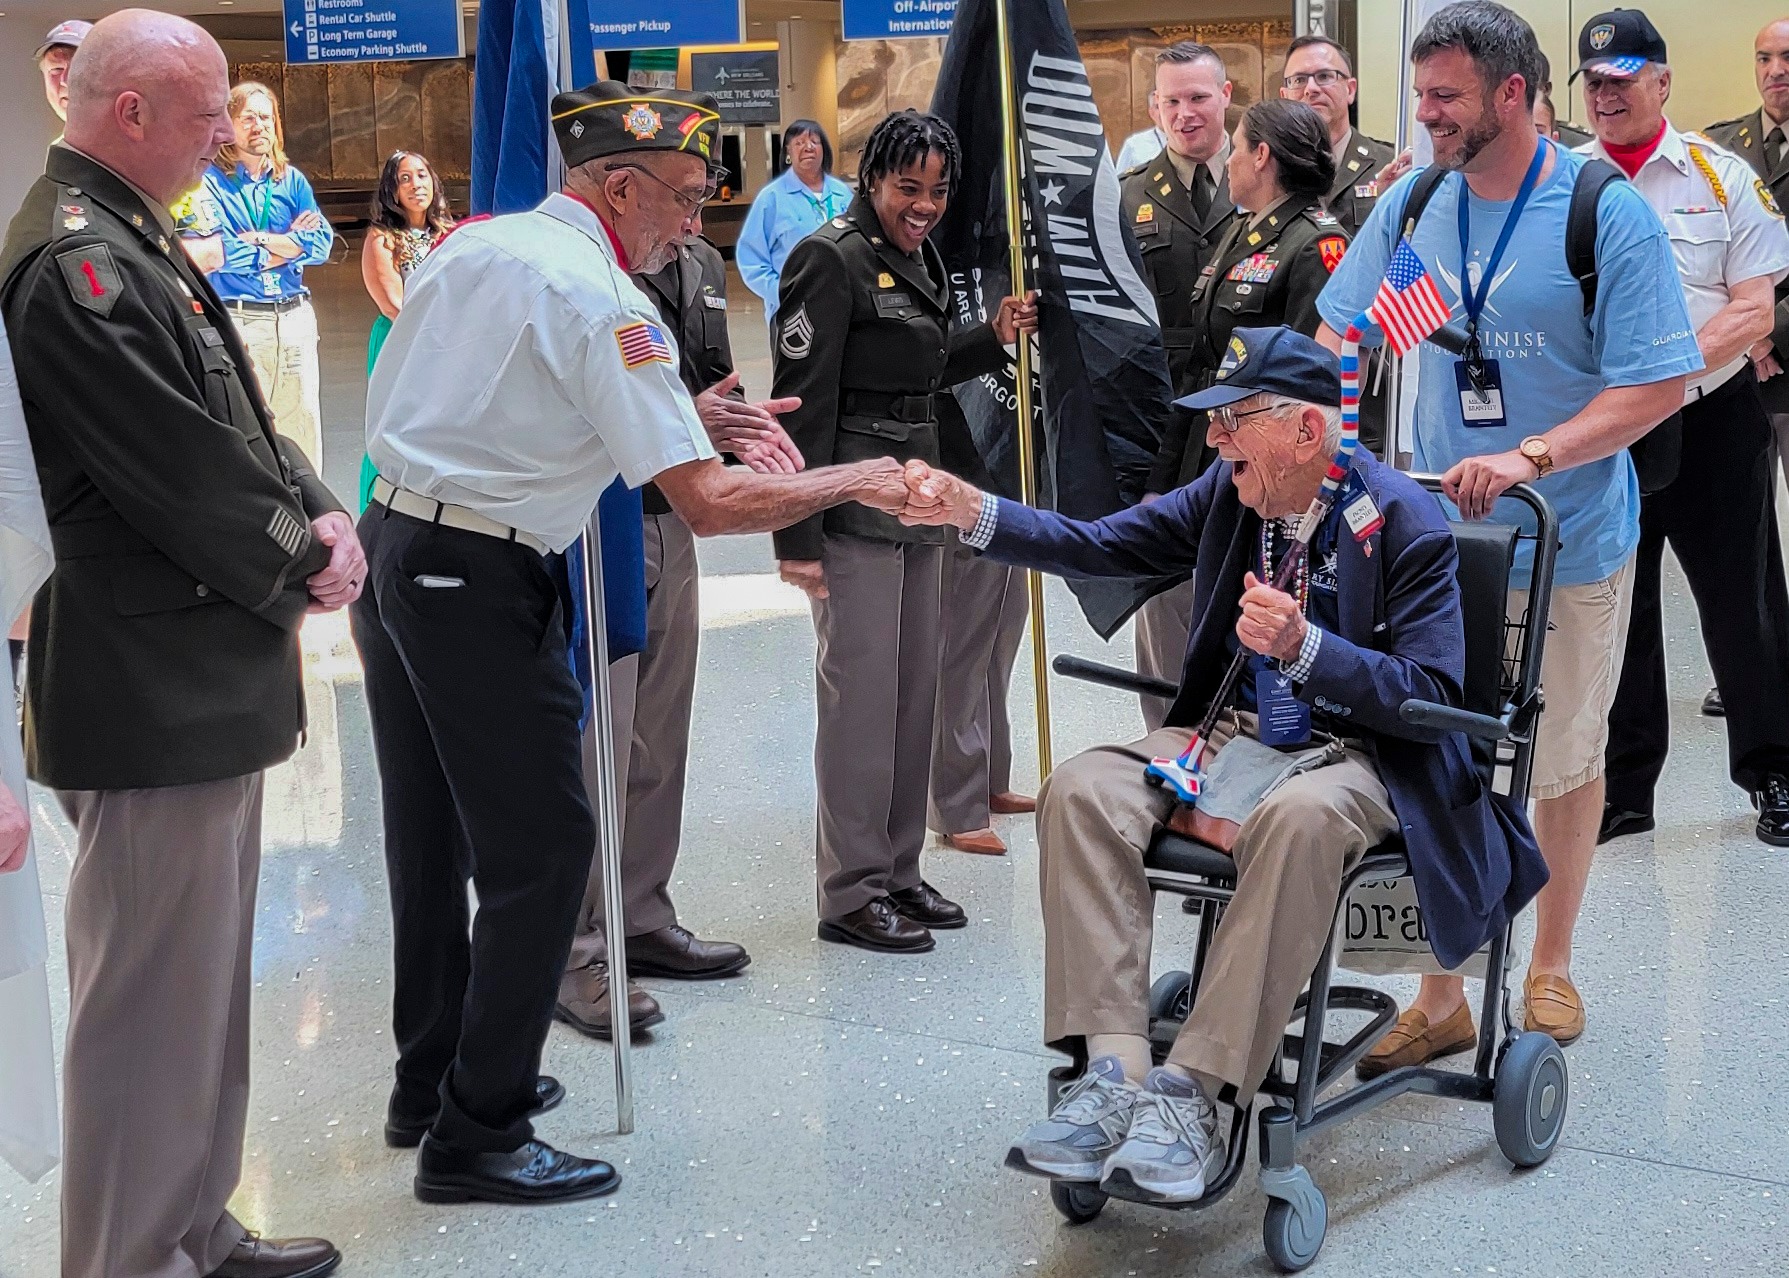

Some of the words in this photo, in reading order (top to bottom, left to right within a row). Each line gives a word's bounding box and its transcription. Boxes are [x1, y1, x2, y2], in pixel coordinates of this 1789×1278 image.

[319, 0, 363, 9] Restrooms
[319, 13, 347, 25] Rental
[348, 13, 363, 23] Car
[364, 11, 397, 22] Shuttle
[639, 20, 671, 33] Pickup
[889, 19, 954, 32] Internation
[320, 31, 342, 42] Long
[343, 29, 365, 40] Term
[366, 28, 398, 41] Garage
[321, 46, 360, 58] Economy
[361, 44, 394, 57] Parking
[395, 42, 428, 54] Shuttle
[734, 89, 751, 99] THE
[954, 290, 973, 325] ARE
[1345, 899, 1429, 942] bra
